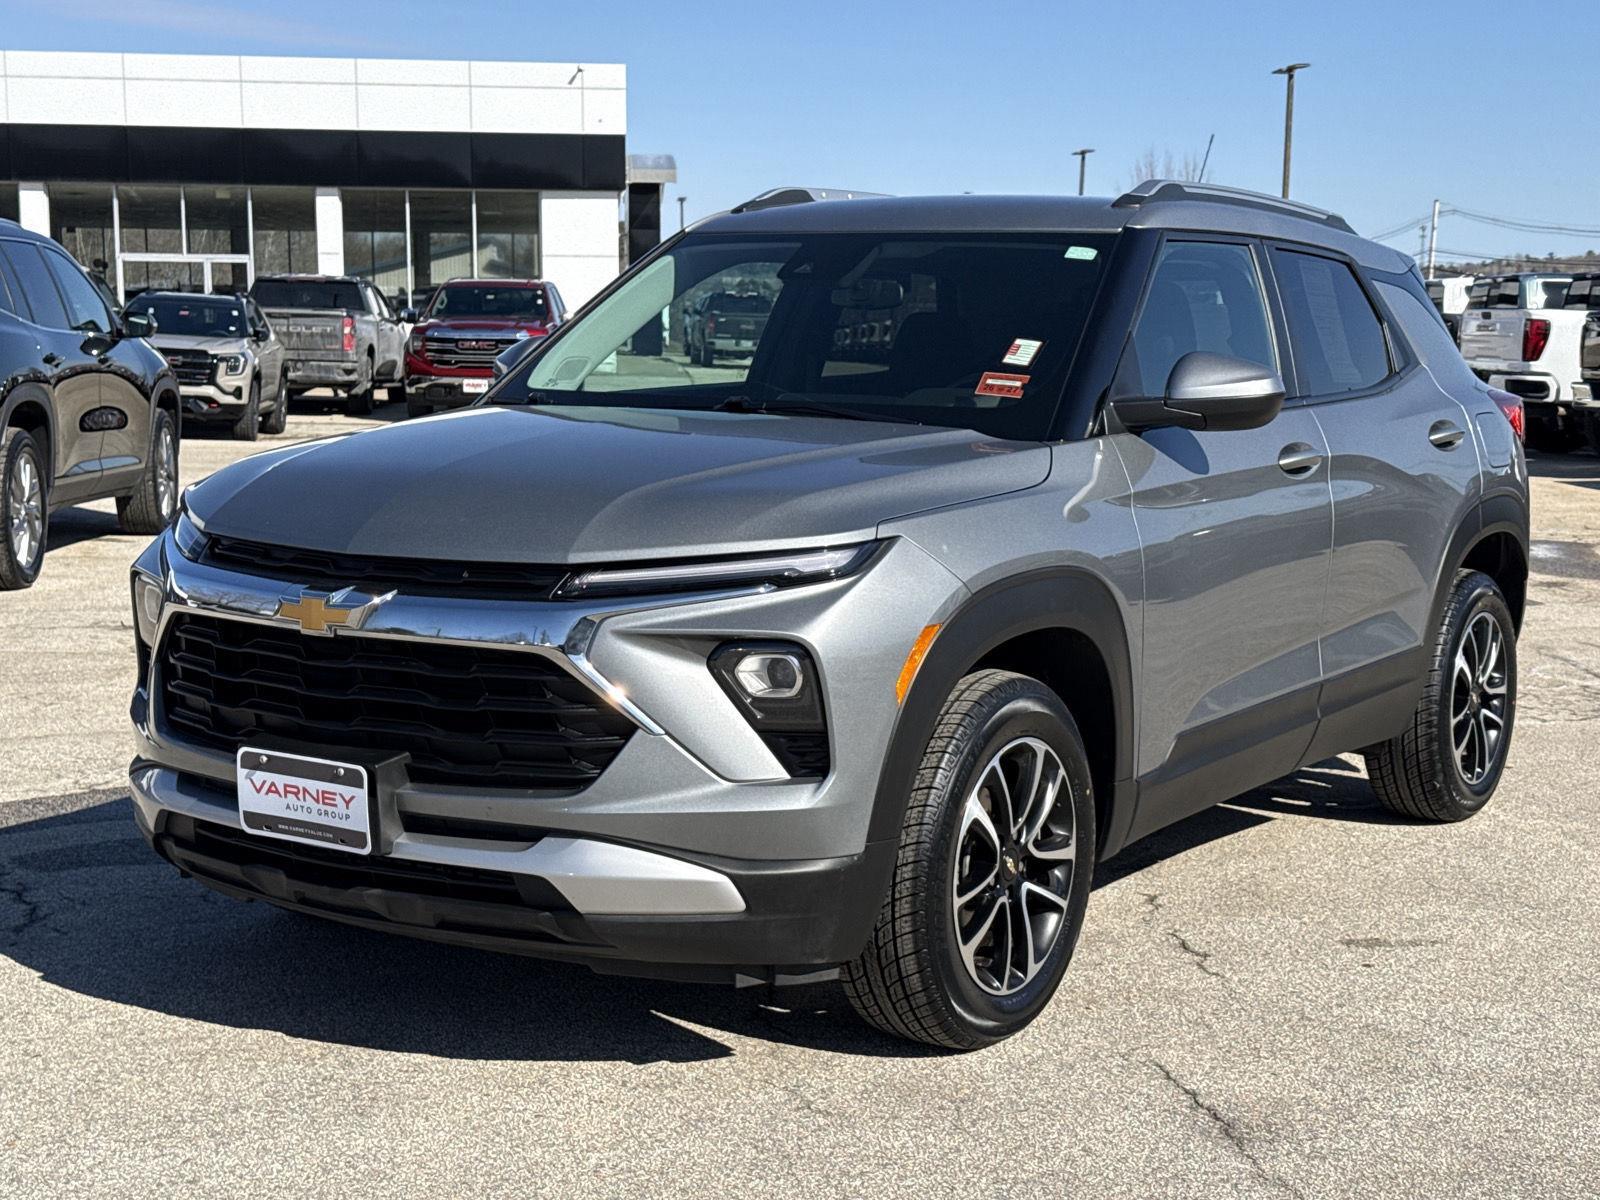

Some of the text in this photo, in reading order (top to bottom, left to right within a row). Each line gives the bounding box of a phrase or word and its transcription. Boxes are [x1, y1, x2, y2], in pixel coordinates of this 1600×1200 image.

[458, 341, 496, 349] GMC
[249, 778, 356, 810] VARNEY
[285, 803, 351, 821] AUTO GROUP
